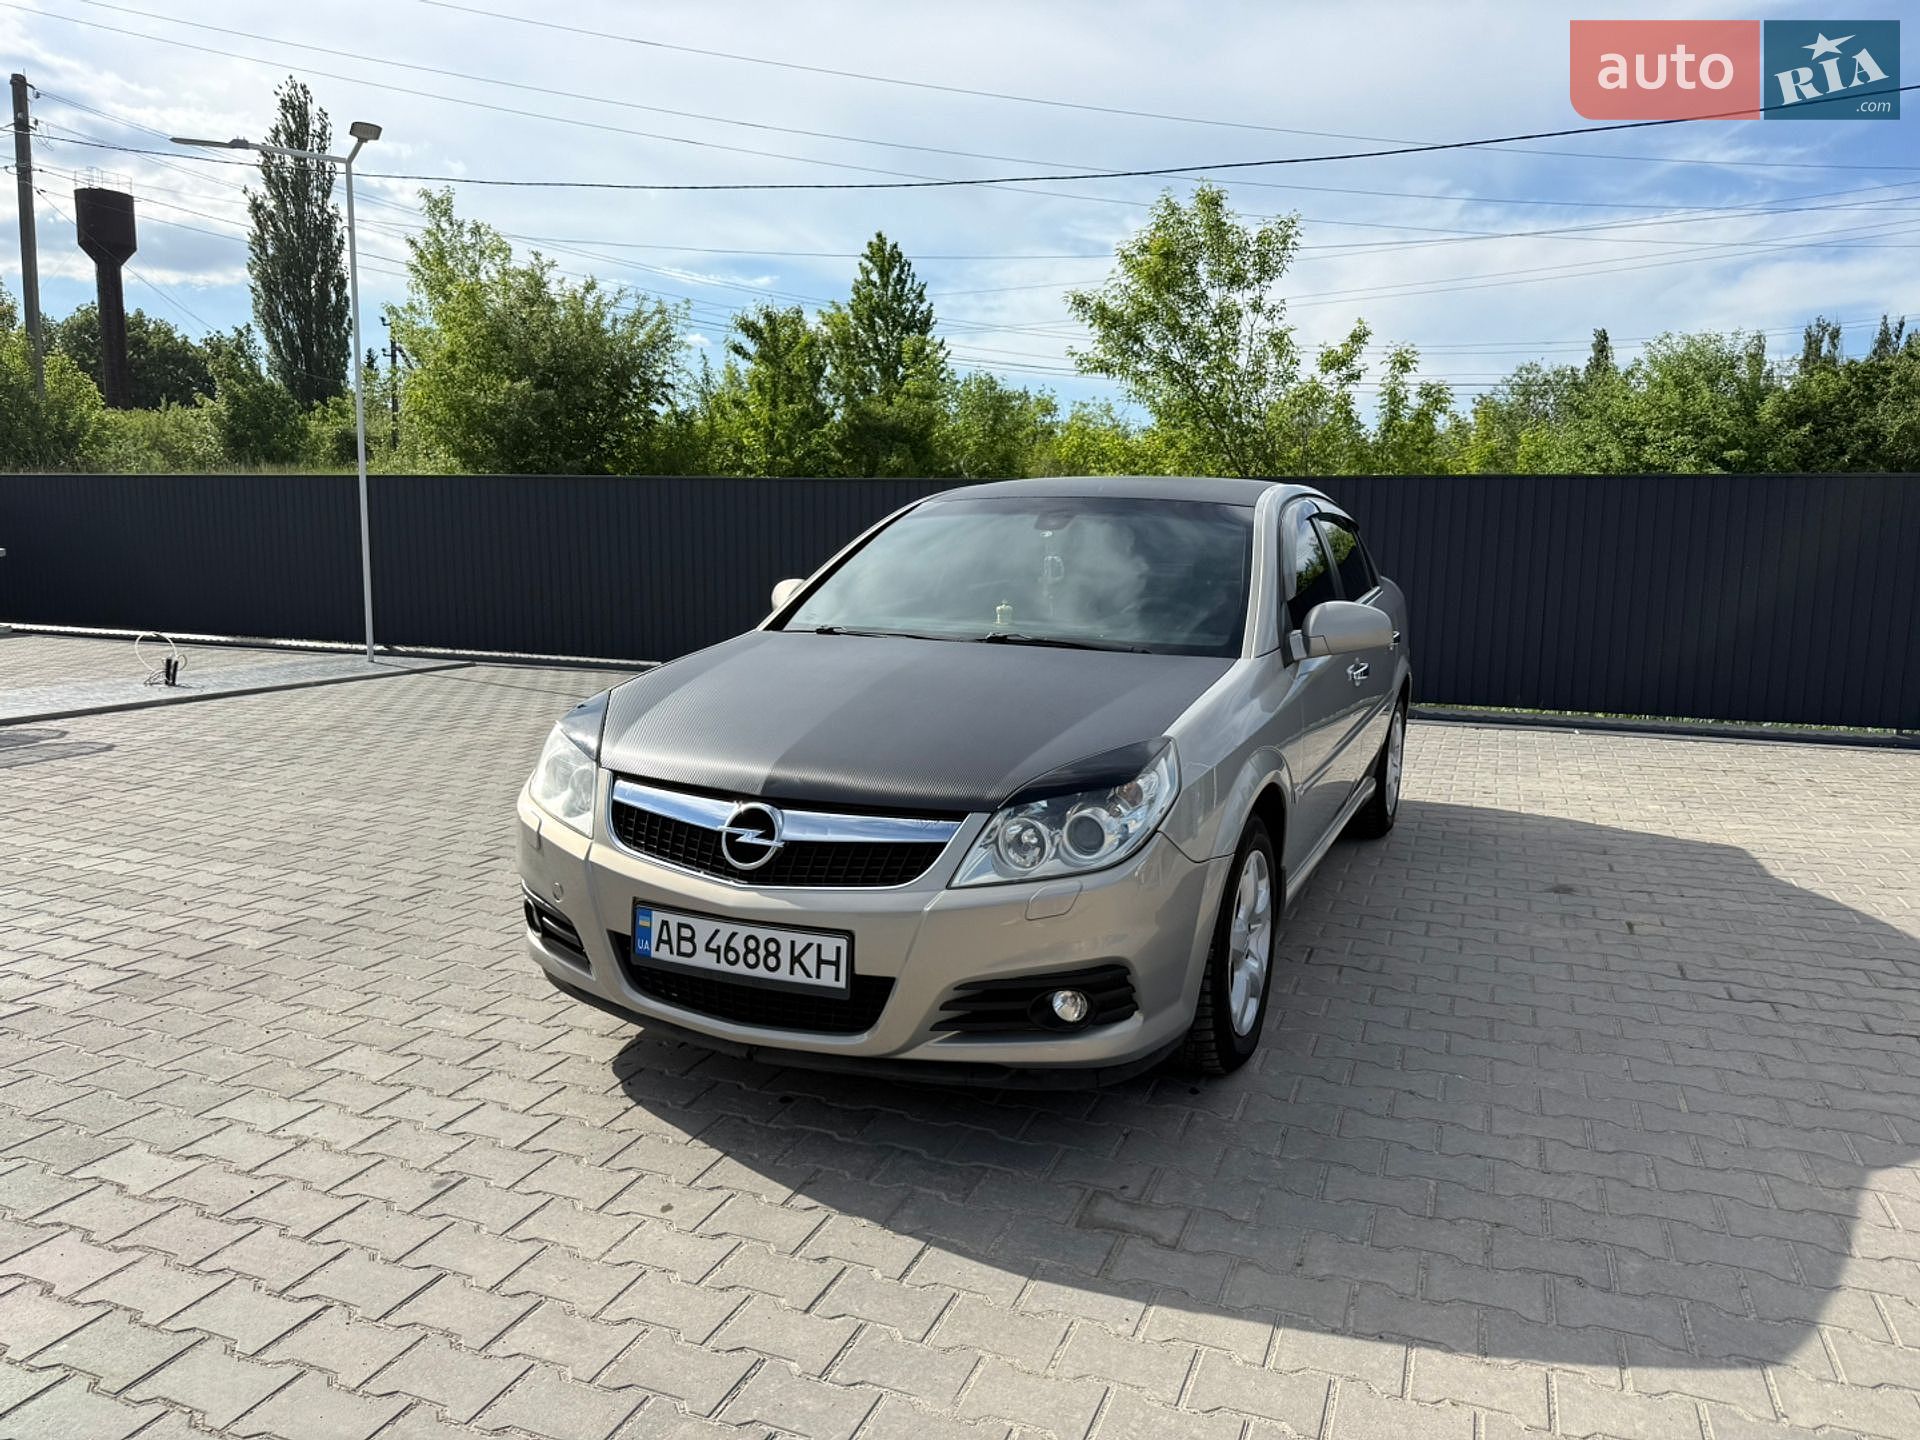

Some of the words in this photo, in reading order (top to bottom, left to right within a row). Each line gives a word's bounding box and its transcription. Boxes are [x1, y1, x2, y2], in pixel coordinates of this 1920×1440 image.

[637, 938, 650, 951] UA
[655, 919, 697, 958] AB
[704, 928, 781, 973] 4688
[789, 940, 841, 982] KH
